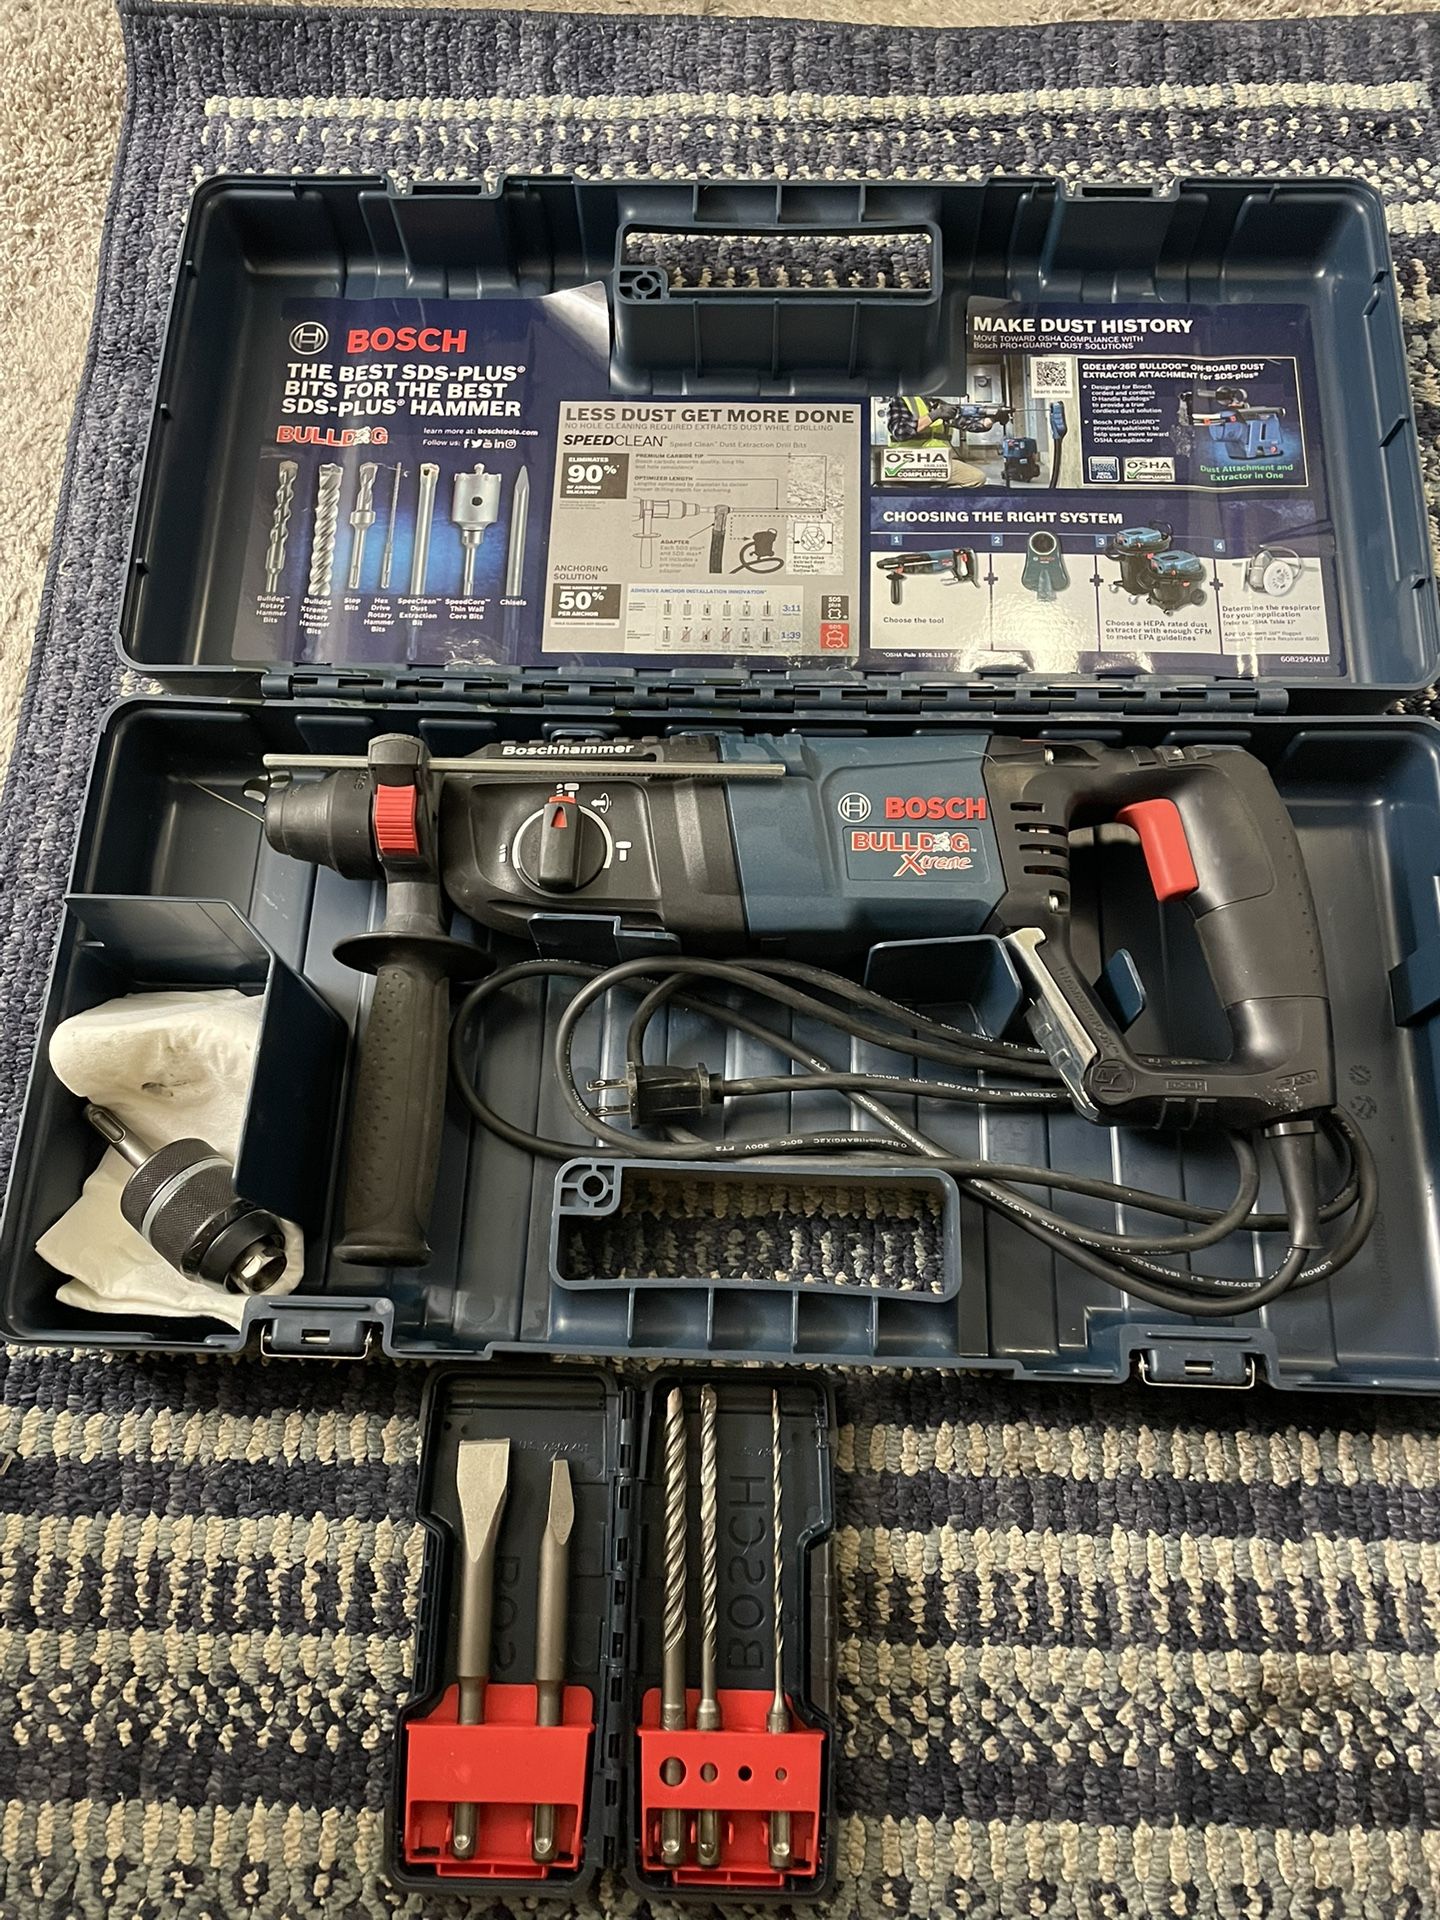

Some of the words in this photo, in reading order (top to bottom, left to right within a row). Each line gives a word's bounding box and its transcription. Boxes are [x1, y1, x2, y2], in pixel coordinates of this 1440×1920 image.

[973, 316, 1036, 332] MAKE
[1040, 318, 1097, 333] DUST
[1101, 319, 1194, 334] HISTORY
[347, 326, 468, 353] BOSCH
[1064, 335, 1119, 343] COMPLIANCE
[973, 341, 999, 349] Bosch
[1060, 342, 1082, 350] DUST
[1085, 343, 1134, 351] SOLUTIONS
[1190, 364, 1238, 372] ON-BOARD
[1240, 362, 1265, 370] DUST
[286, 362, 334, 380] THE
[338, 363, 398, 382] BEST
[1082, 371, 1137, 379] EXTRACTOR
[1138, 371, 1198, 380] ATTACHMENT
[1200, 372, 1213, 380] for
[284, 380, 338, 397] BITS
[343, 381, 390, 399] FOR
[395, 382, 441, 398] THE
[447, 383, 508, 399] BEST
[409, 400, 521, 417] HAMMER
[566, 407, 616, 421] LESS
[621, 408, 677, 422] DUST
[680, 409, 722, 423] GET
[727, 409, 790, 423] MORE
[795, 410, 855, 425] DONE
[477, 427, 539, 436] boschtools.com
[565, 422, 578, 430] NO
[580, 422, 602, 430] HOLE
[650, 423, 693, 431] REQUIRED
[694, 423, 738, 432] EXTRACTS
[740, 424, 762, 432] DUST
[765, 424, 791, 432] WHILE
[794, 424, 834, 432] DRILLING
[422, 438, 446, 447] Follow
[886, 453, 947, 463] OSHA
[1127, 461, 1171, 469] OSHA
[1200, 464, 1219, 473] Dust
[1222, 464, 1273, 473] Attachment
[1275, 463, 1293, 471] and
[1210, 472, 1252, 481] Extractor
[1254, 472, 1263, 480] in
[1265, 472, 1284, 480] One
[882, 511, 969, 523] CHOOSING
[971, 512, 1004, 523] THE
[1006, 512, 1057, 524] RIGHT
[1060, 512, 1124, 525] SYSTEM
[554, 564, 608, 572] ANCHORING
[558, 591, 606, 610] 50%
[260, 602, 285, 610] Rotary
[781, 604, 801, 613] 3:11
[1281, 604, 1321, 612] respirator
[303, 612, 328, 621] Rotary
[367, 611, 392, 619] Rotary
[1256, 611, 1302, 619] application
[929, 616, 945, 624] tool
[1143, 619, 1165, 627] HEPA
[1190, 620, 1208, 628] dust
[1163, 627, 1192, 635] enough
[780, 632, 801, 641] 1:39
[1156, 634, 1197, 642] guidelines
[501, 744, 635, 756] Boschhammer
[884, 796, 987, 820] BOSCH
[893, 849, 975, 877] Xtreme
[1299, 1259, 1333, 1280] LOROM
[728, 1474, 768, 1672] BOSCH
